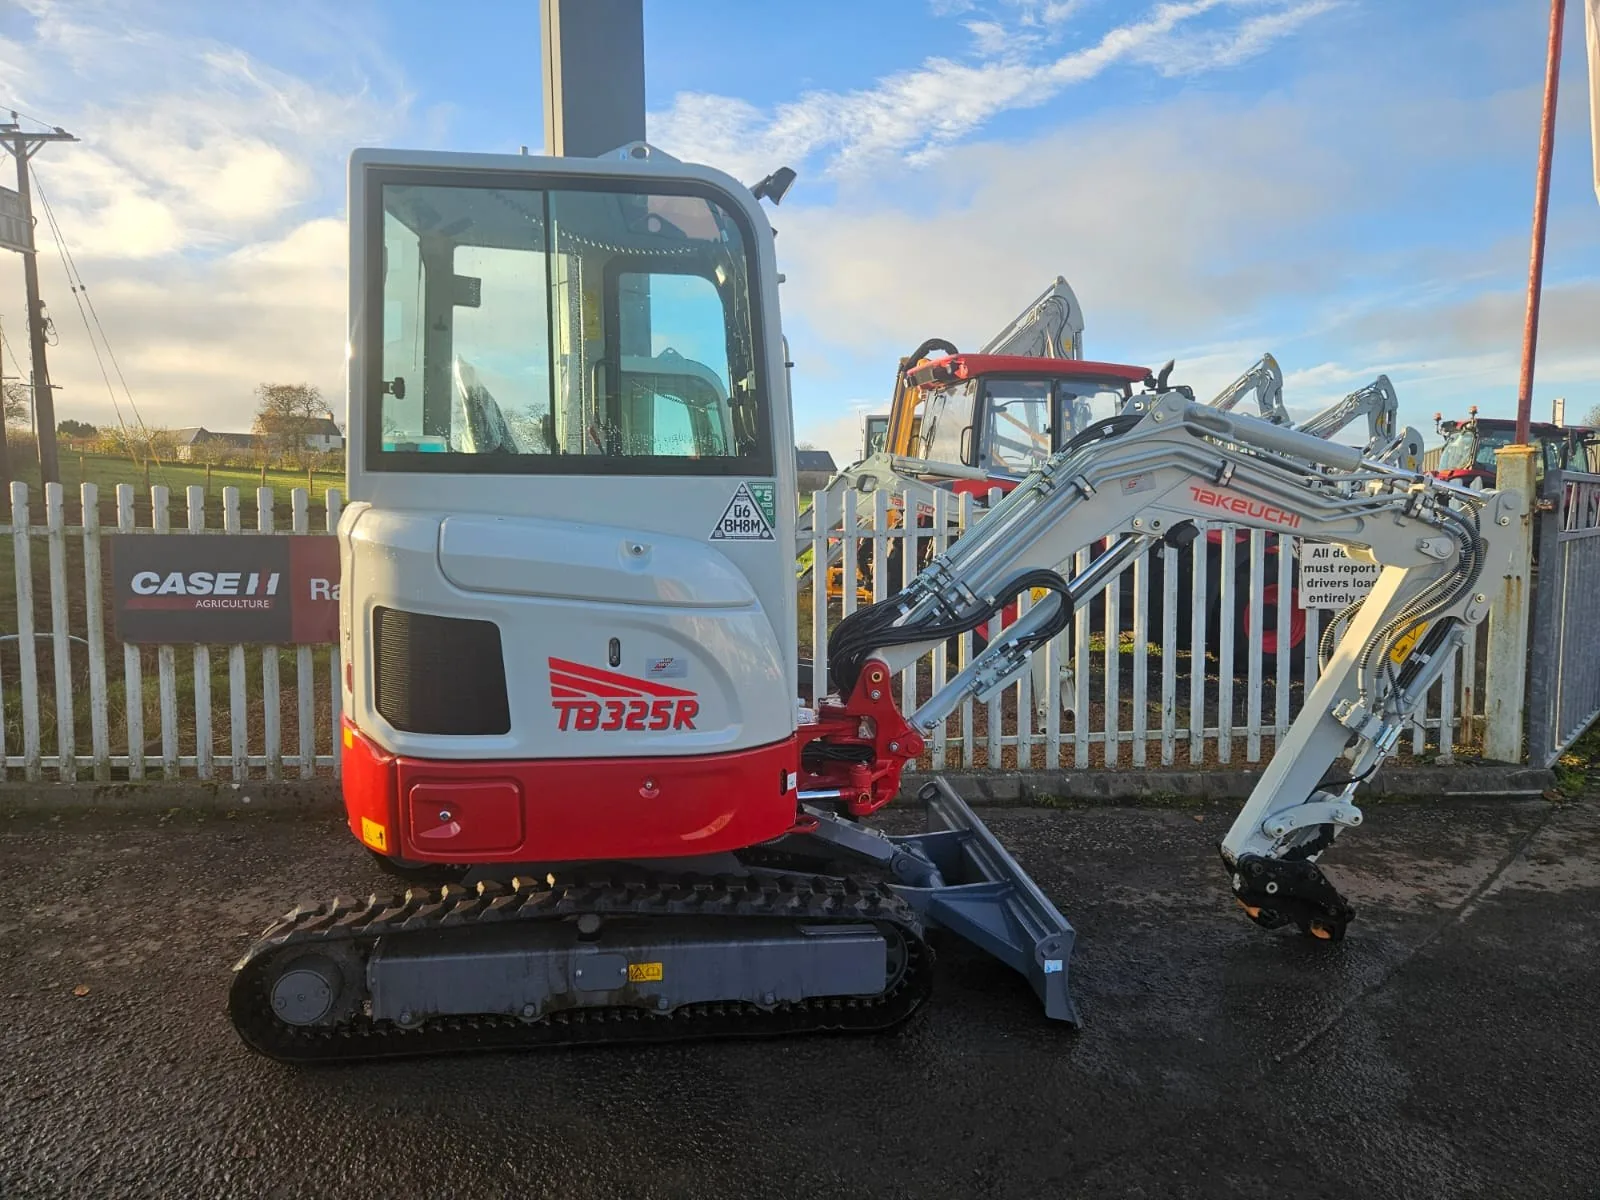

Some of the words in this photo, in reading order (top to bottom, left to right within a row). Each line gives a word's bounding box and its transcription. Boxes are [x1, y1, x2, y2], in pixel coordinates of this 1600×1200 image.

[763, 490, 773, 501] 5
[1312, 548, 1329, 558] All
[1303, 564, 1335, 573] must
[1338, 564, 1376, 575] report
[130, 571, 242, 595] CASE
[1306, 578, 1349, 588] drivers
[195, 599, 270, 608] AGRICULTURE
[1308, 593, 1356, 605] entirely
[552, 700, 700, 732] TB325R
